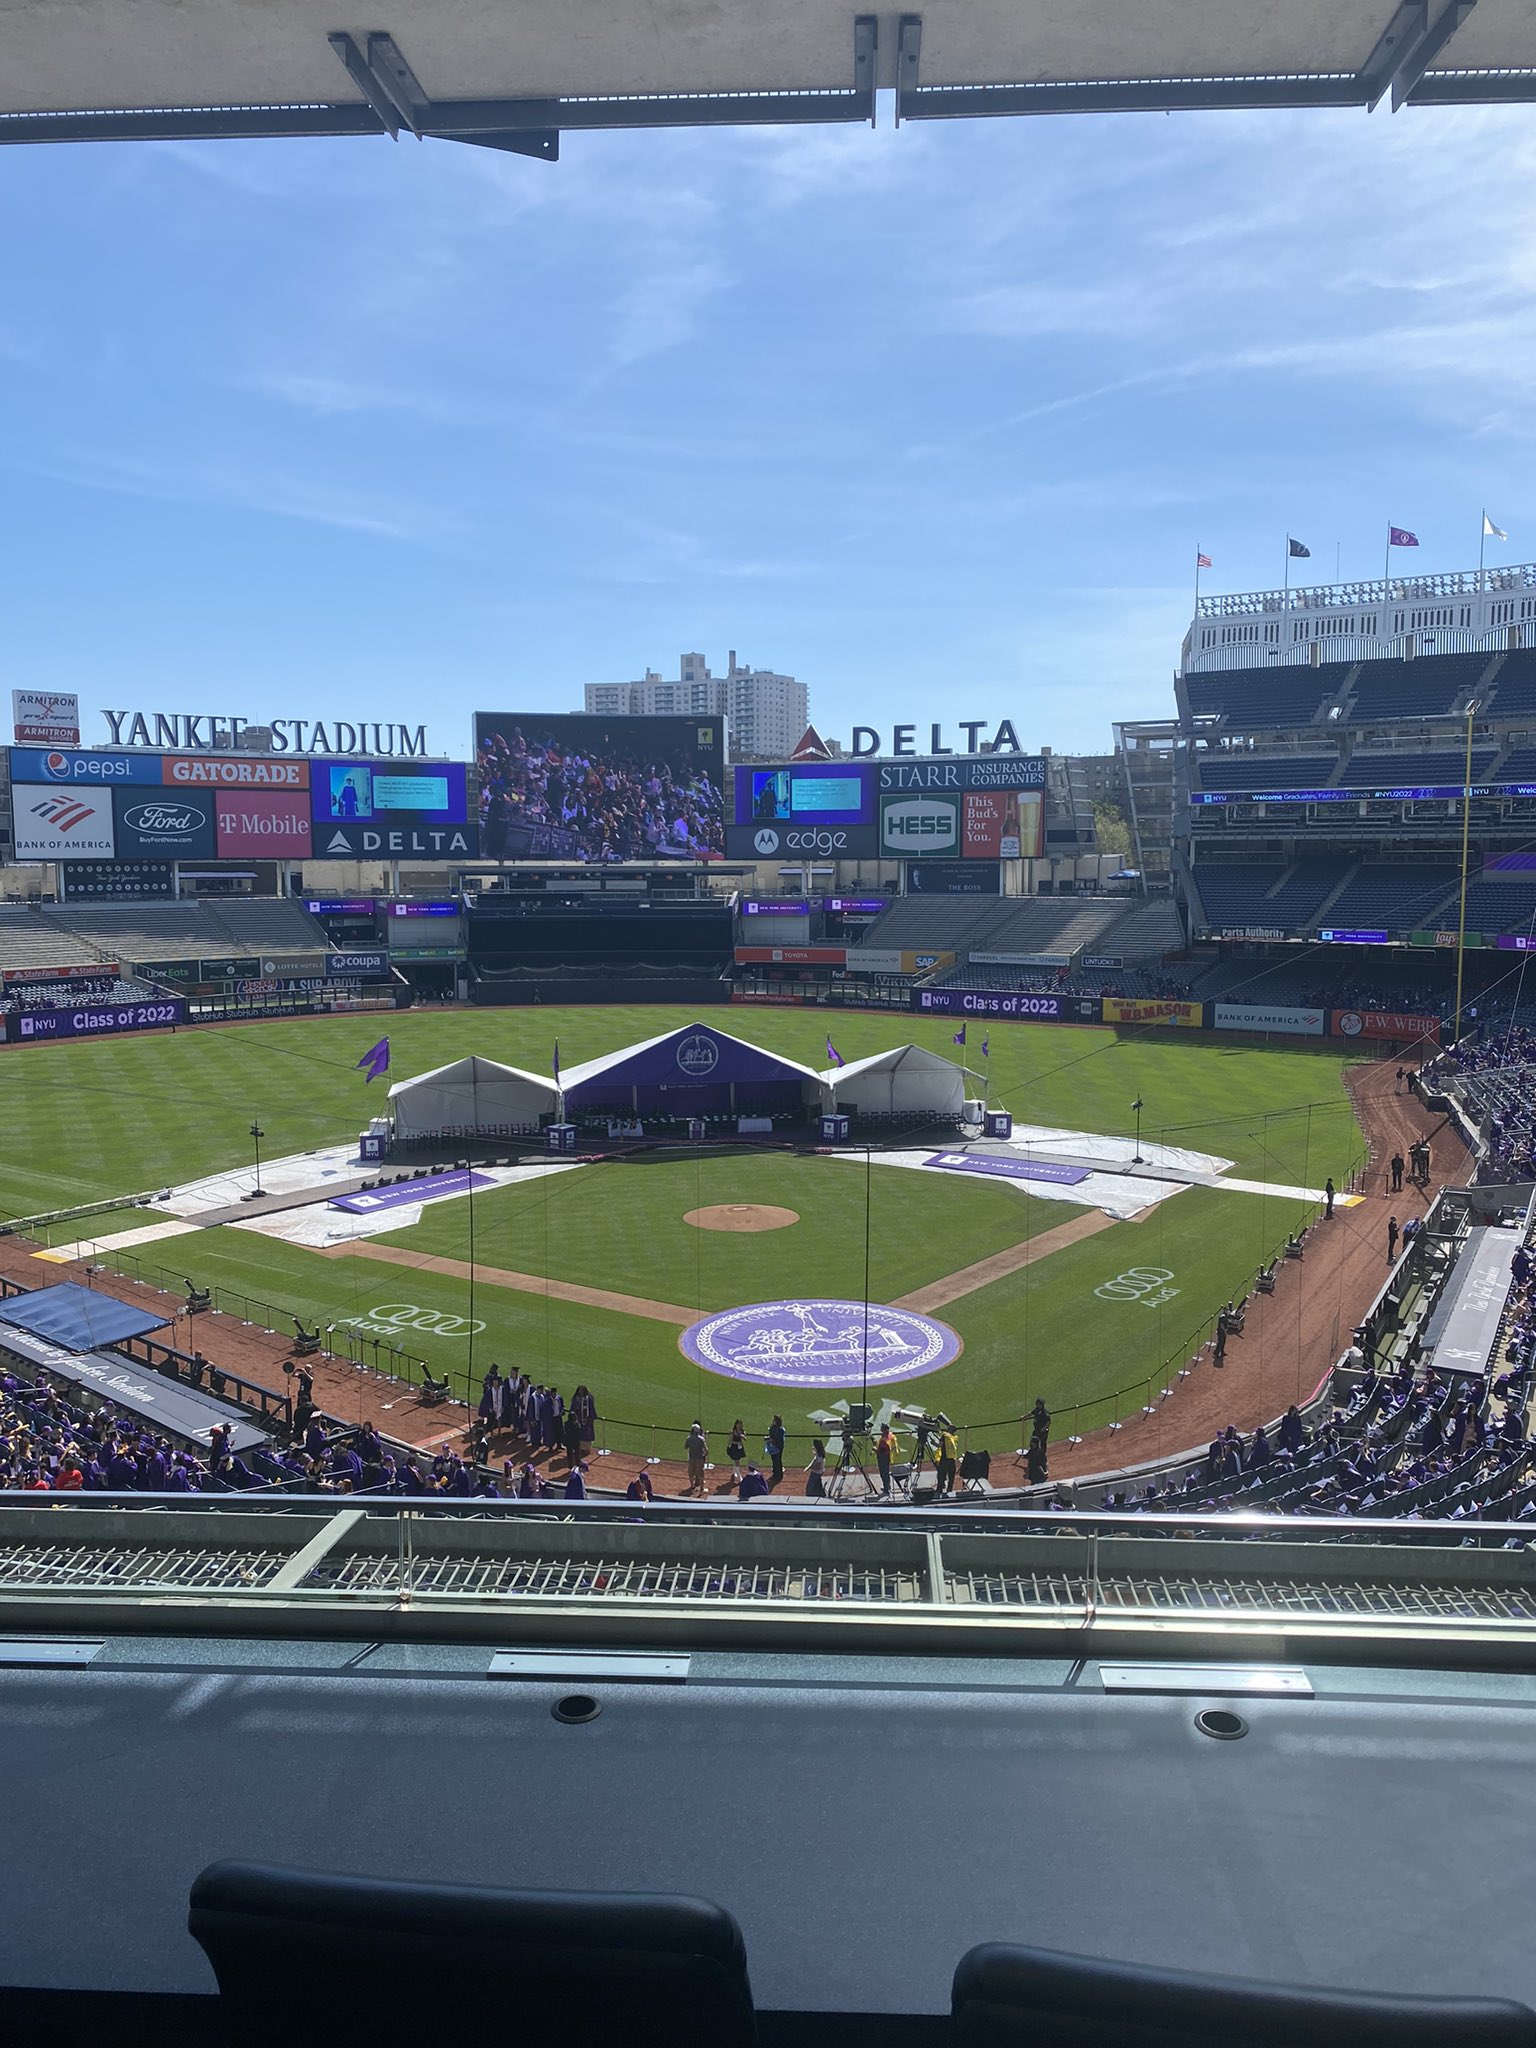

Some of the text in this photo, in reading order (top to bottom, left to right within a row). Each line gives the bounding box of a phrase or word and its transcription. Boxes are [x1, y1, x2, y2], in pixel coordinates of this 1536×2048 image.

[19, 695, 75, 707] ARMITRON
[24, 727, 74, 737] ARMITRON
[100, 709, 428, 757] YANKEE STADIUM
[852, 719, 1024, 757] DELTA
[74, 759, 130, 778] pepsi
[172, 762, 300, 784] GATORADE
[880, 765, 961, 788] STARR
[972, 761, 1045, 775] INSURANCE
[971, 772, 1045, 786] COMPANIES
[966, 796, 993, 808] This
[138, 806, 191, 829] Ford
[967, 808, 998, 819] Bud's
[888, 816, 952, 835] HESS
[967, 820, 986, 830] For
[16, 840, 47, 850] BANK
[64, 841, 112, 850] AMERICA
[363, 832, 468, 851] DELTA
[786, 827, 847, 856] edge
[966, 831, 992, 842] You.
[1222, 927, 1284, 938] Parts Authority
[347, 956, 381, 968] coupa
[916, 957, 935, 967] SAP
[168, 968, 190, 976] Eats
[192, 1006, 295, 1021] StubHub StubHub StubHub
[932, 996, 950, 1006] NYU
[963, 995, 999, 1011] Class
[1002, 998, 1018, 1012] of
[1020, 999, 1058, 1014] 2022
[35, 1006, 175, 1030] NYU Class of 2022
[1217, 1012, 1300, 1025] BANK OF AMERICA
[1364, 1015, 1434, 1032] F.W. WEBB
[968, 1160, 1074, 1178] NEW YORK UNIVERSITY
[379, 1174, 472, 1200] NEW YORK UNIVERSITY
[1140, 1286, 1182, 1308] Audi
[338, 1316, 406, 1335] Audi
[719, 1311, 778, 1336] NEW YORK
[821, 1308, 907, 1327] UNIVERSITY
